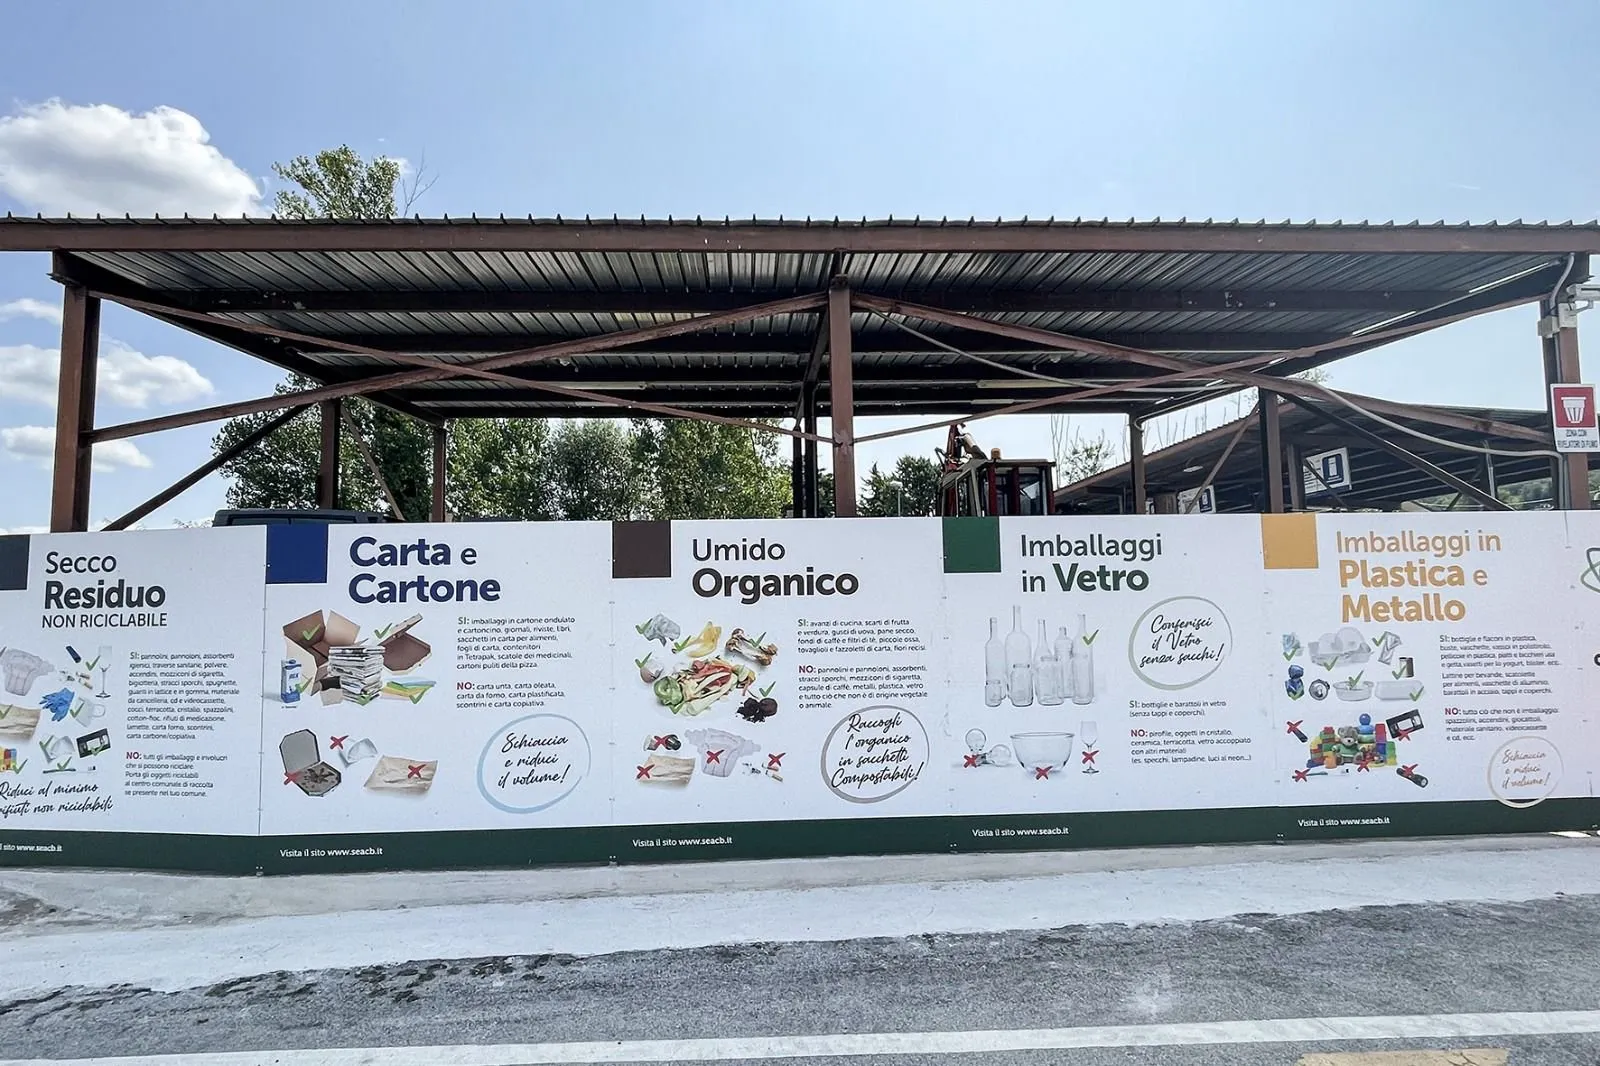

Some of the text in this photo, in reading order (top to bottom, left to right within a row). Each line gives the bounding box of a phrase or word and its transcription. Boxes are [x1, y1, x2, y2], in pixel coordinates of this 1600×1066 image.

[349, 537, 477, 567] Carta e
[693, 538, 785, 561] Umido
[1021, 533, 1162, 561] Imballaggi
[1337, 530, 1501, 557] Imballaggi in
[46, 551, 117, 574] Secco
[1022, 563, 1149, 592] in Vetro
[1339, 559, 1488, 588] Plastica e
[45, 579, 165, 609] Residuo
[349, 573, 500, 604] Cartone
[692, 567, 859, 605] Organico
[1342, 593, 1466, 623] Metallo
[42, 613, 168, 628] NON RICICLABILE
[471, 618, 507, 626] imballaggi
[1151, 614, 1212, 633] Conferisci
[1152, 630, 1202, 651] il Vetro
[1140, 643, 1224, 668] senza sacchi!
[457, 682, 476, 690] NO:
[847, 712, 902, 733] Raccogli
[1131, 729, 1148, 737] NO:
[501, 732, 568, 753] Schiaccia
[126, 752, 142, 760] NO:
[505, 751, 558, 767] e riduci
[839, 747, 910, 768] in sacchetti
[1502, 749, 1546, 764] Schiaccia
[498, 764, 571, 788] il volume!
[832, 762, 924, 789] Compostabili!
[1514, 763, 1541, 773] riduci
[0, 781, 98, 799] Riduci al minimo
[1502, 772, 1551, 789] il volume!
[34, 804, 54, 813] non
[58, 796, 113, 812] riciclabili
[972, 829, 993, 837] Visita
[1017, 827, 1069, 835] www.seacb.it
[1298, 819, 1318, 827] Visita
[1340, 817, 1390, 825] www.seacb.it
[327, 848, 383, 856] www.seacb.it
[632, 839, 654, 847] Visita
[678, 837, 732, 846] www.seacb.it
